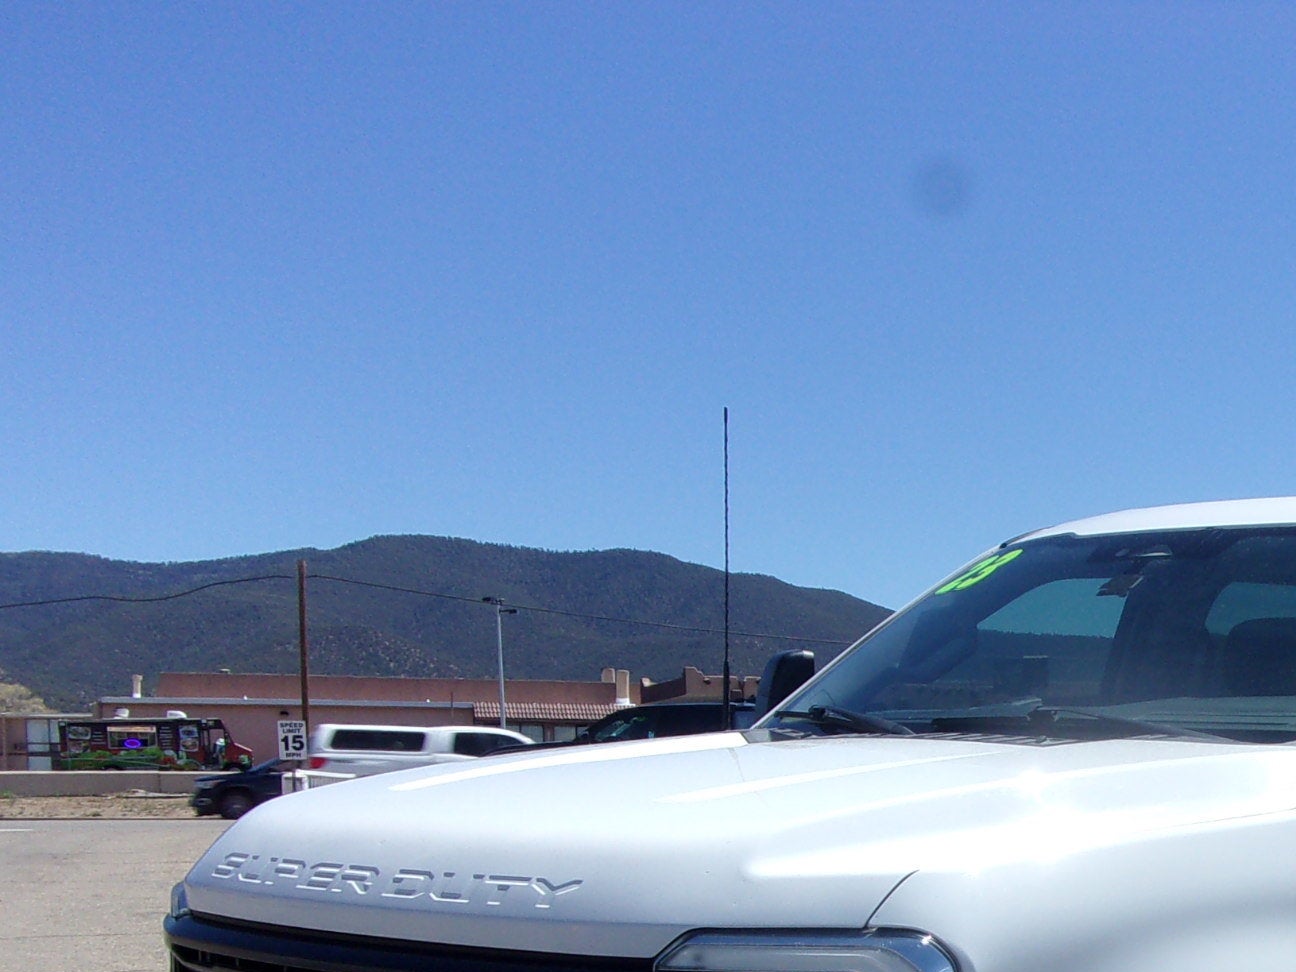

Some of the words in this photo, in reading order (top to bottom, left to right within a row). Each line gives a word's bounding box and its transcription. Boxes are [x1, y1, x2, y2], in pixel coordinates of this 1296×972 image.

[934, 548, 1024, 596] 23
[280, 735, 304, 751] 15
[211, 852, 380, 895] SUPER
[381, 868, 584, 909] DUTY
